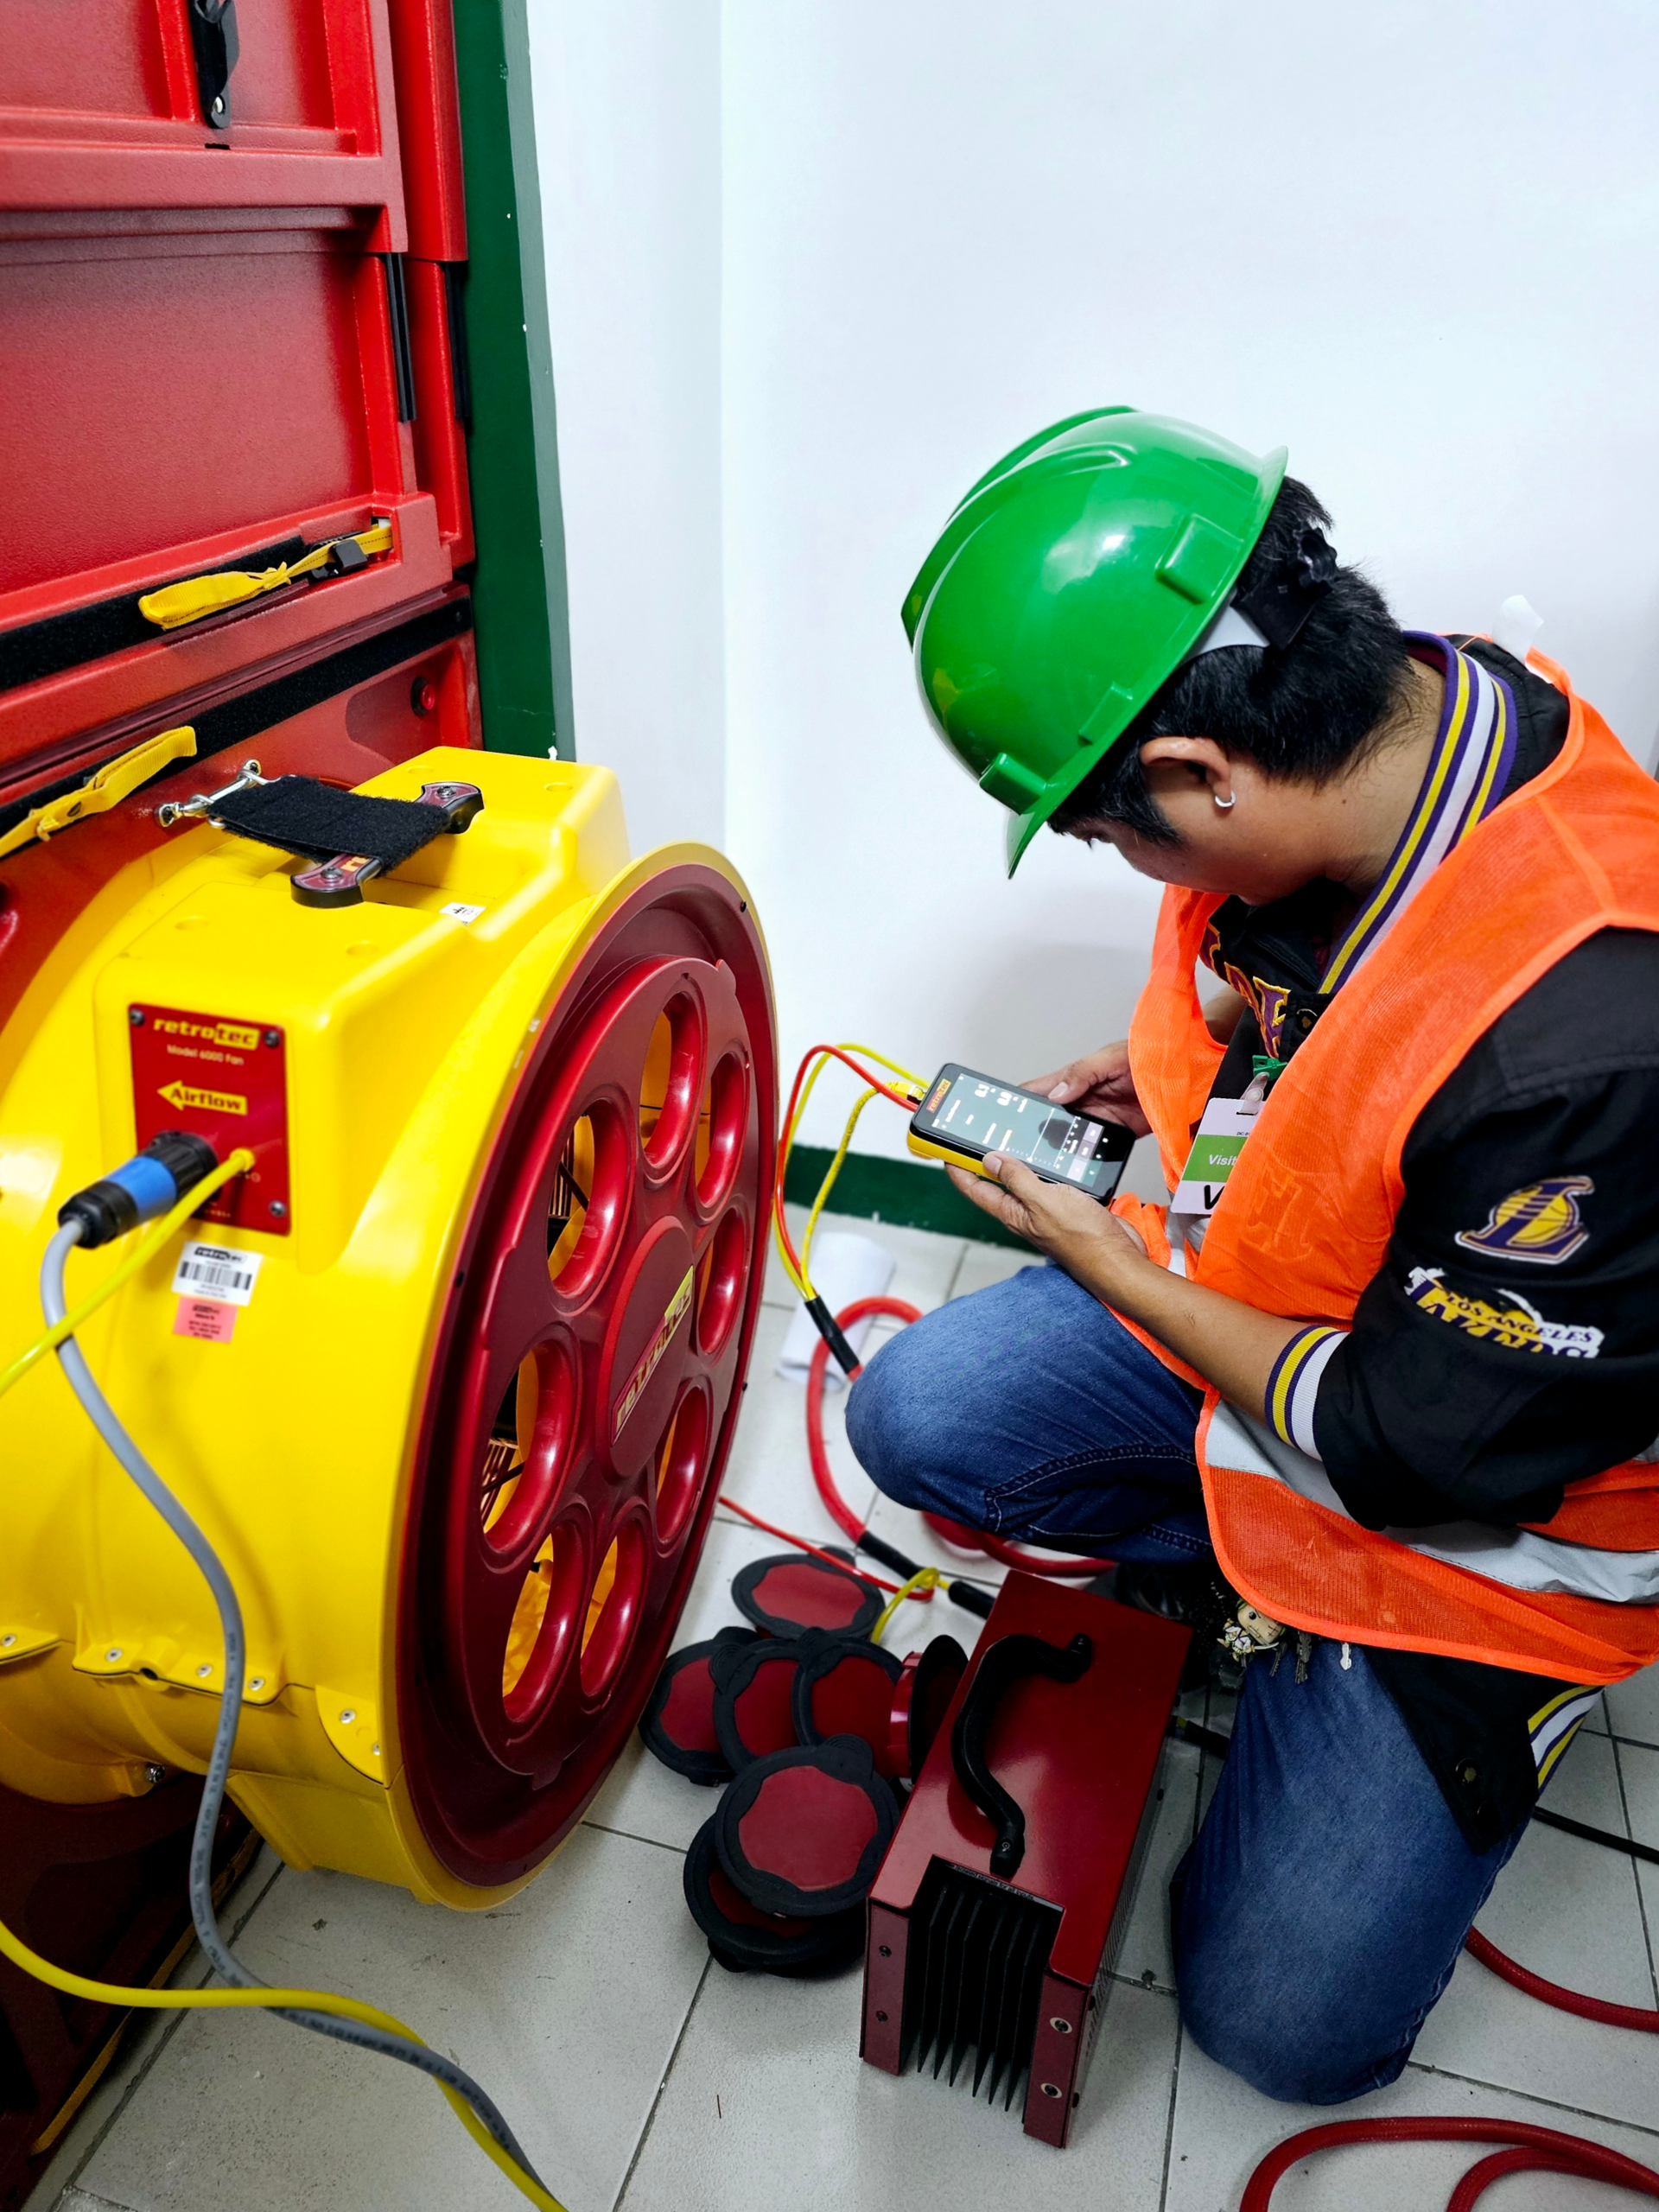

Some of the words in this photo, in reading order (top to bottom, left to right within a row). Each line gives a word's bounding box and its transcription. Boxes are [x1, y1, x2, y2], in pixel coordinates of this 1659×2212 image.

[153, 1018, 255, 1047] retrotec
[167, 1044, 198, 1058] Model
[170, 1087, 242, 1110] Airflow
[928, 1079, 950, 1113] retrotec
[1446, 1291, 1484, 1317] LOS
[1487, 1315, 1594, 1344] ANGELES
